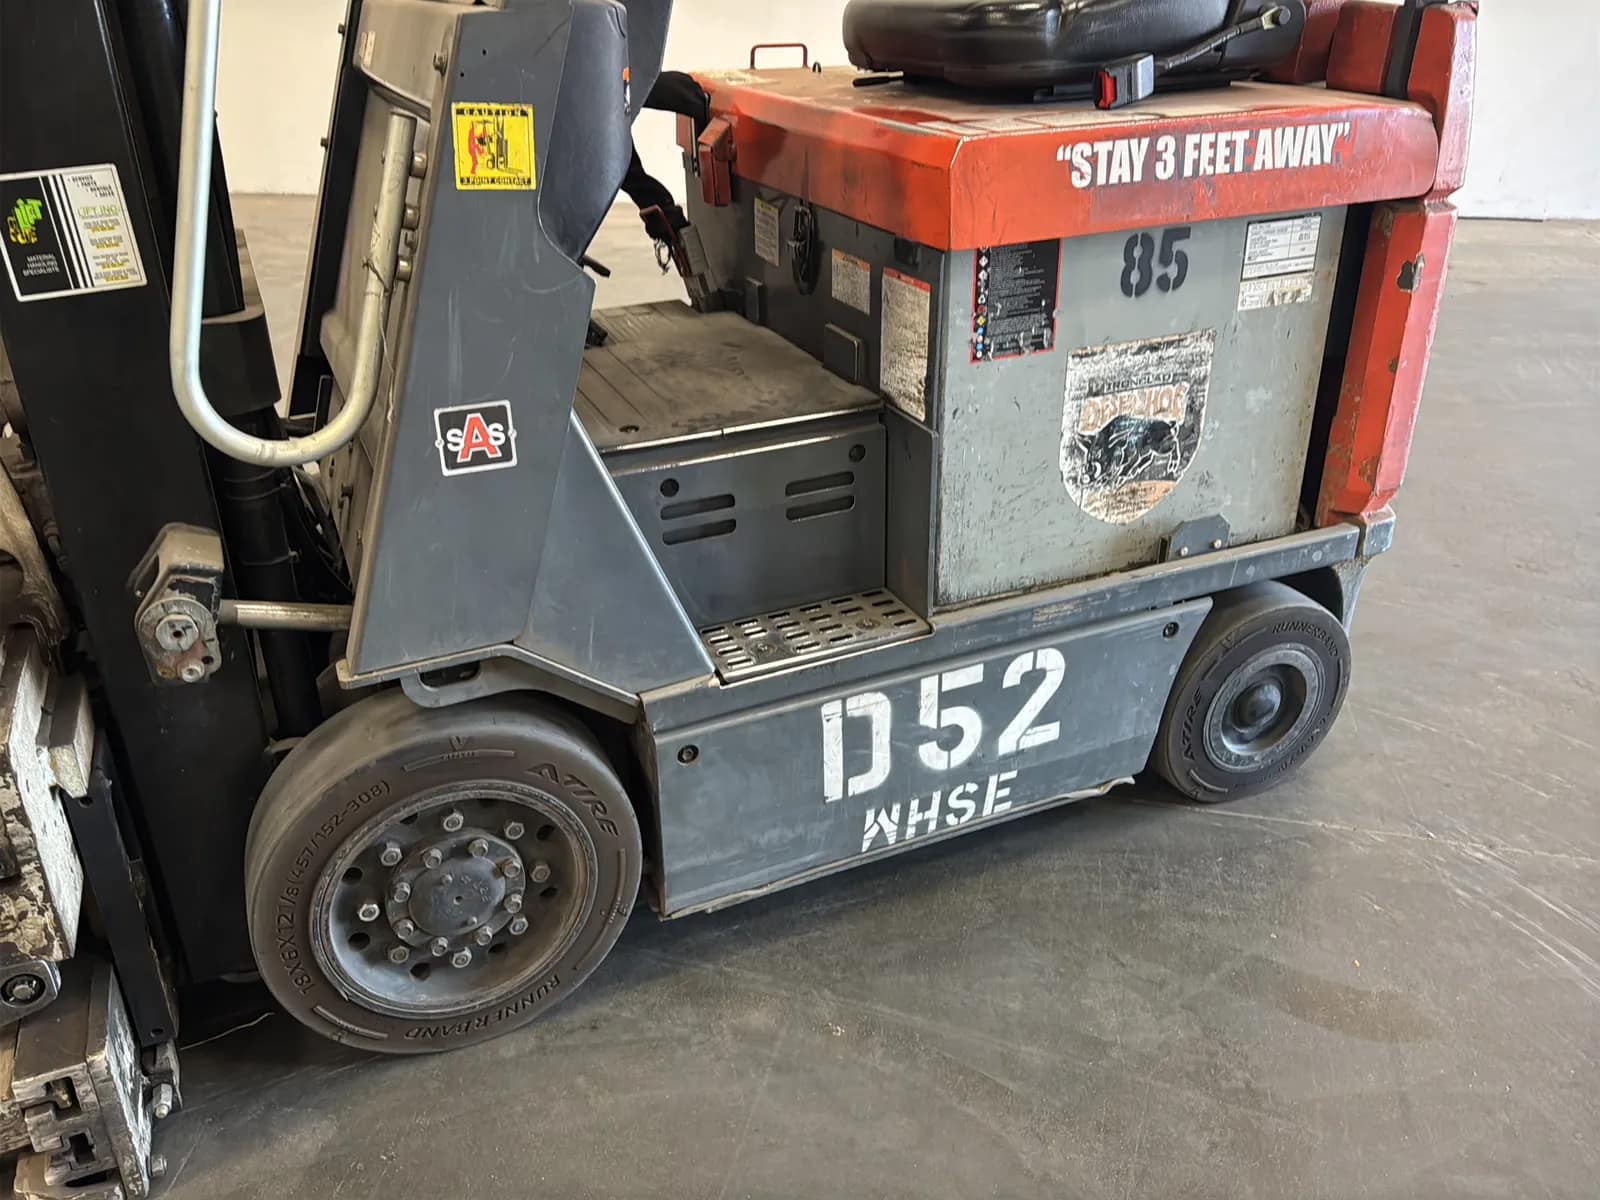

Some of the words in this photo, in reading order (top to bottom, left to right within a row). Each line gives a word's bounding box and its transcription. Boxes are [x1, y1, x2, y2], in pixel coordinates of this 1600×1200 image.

[1155, 135, 1177, 181] 3
[1183, 129, 1251, 178] FEET
[1120, 227, 1192, 298] 85
[524, 762, 620, 838] ATIRE
[861, 769, 1018, 853] WHSE
[404, 973, 561, 1041] RUNNERBAND
